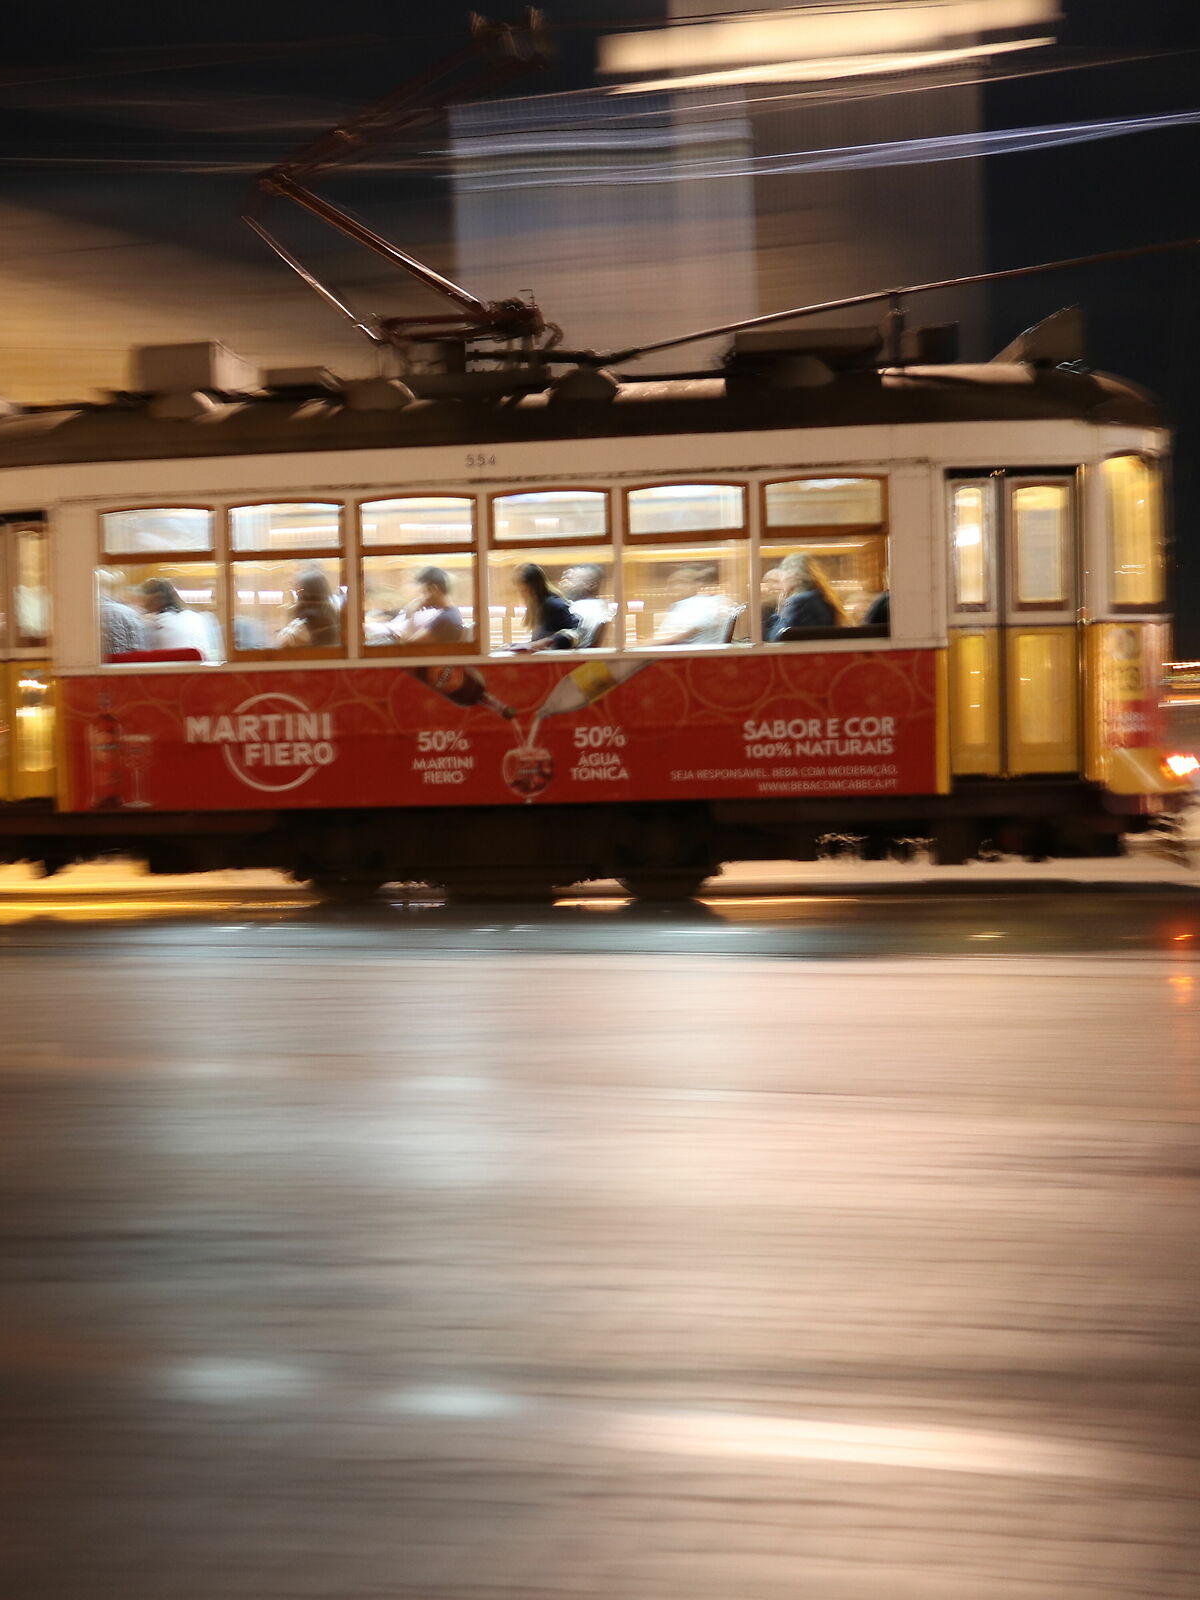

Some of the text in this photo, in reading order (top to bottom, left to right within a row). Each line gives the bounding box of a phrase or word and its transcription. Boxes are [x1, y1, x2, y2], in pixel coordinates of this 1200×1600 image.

[186, 713, 332, 743] MARTINI
[573, 726, 627, 748] 50%
[743, 717, 895, 740] SABOR E COR
[417, 730, 470, 751] 50%
[745, 738, 894, 758] 100% NATURAIS
[244, 742, 335, 766] FIERO
[412, 756, 474, 770] MARTINI
[578, 750, 621, 767] ÁGUA
[422, 771, 465, 784] FIERO
